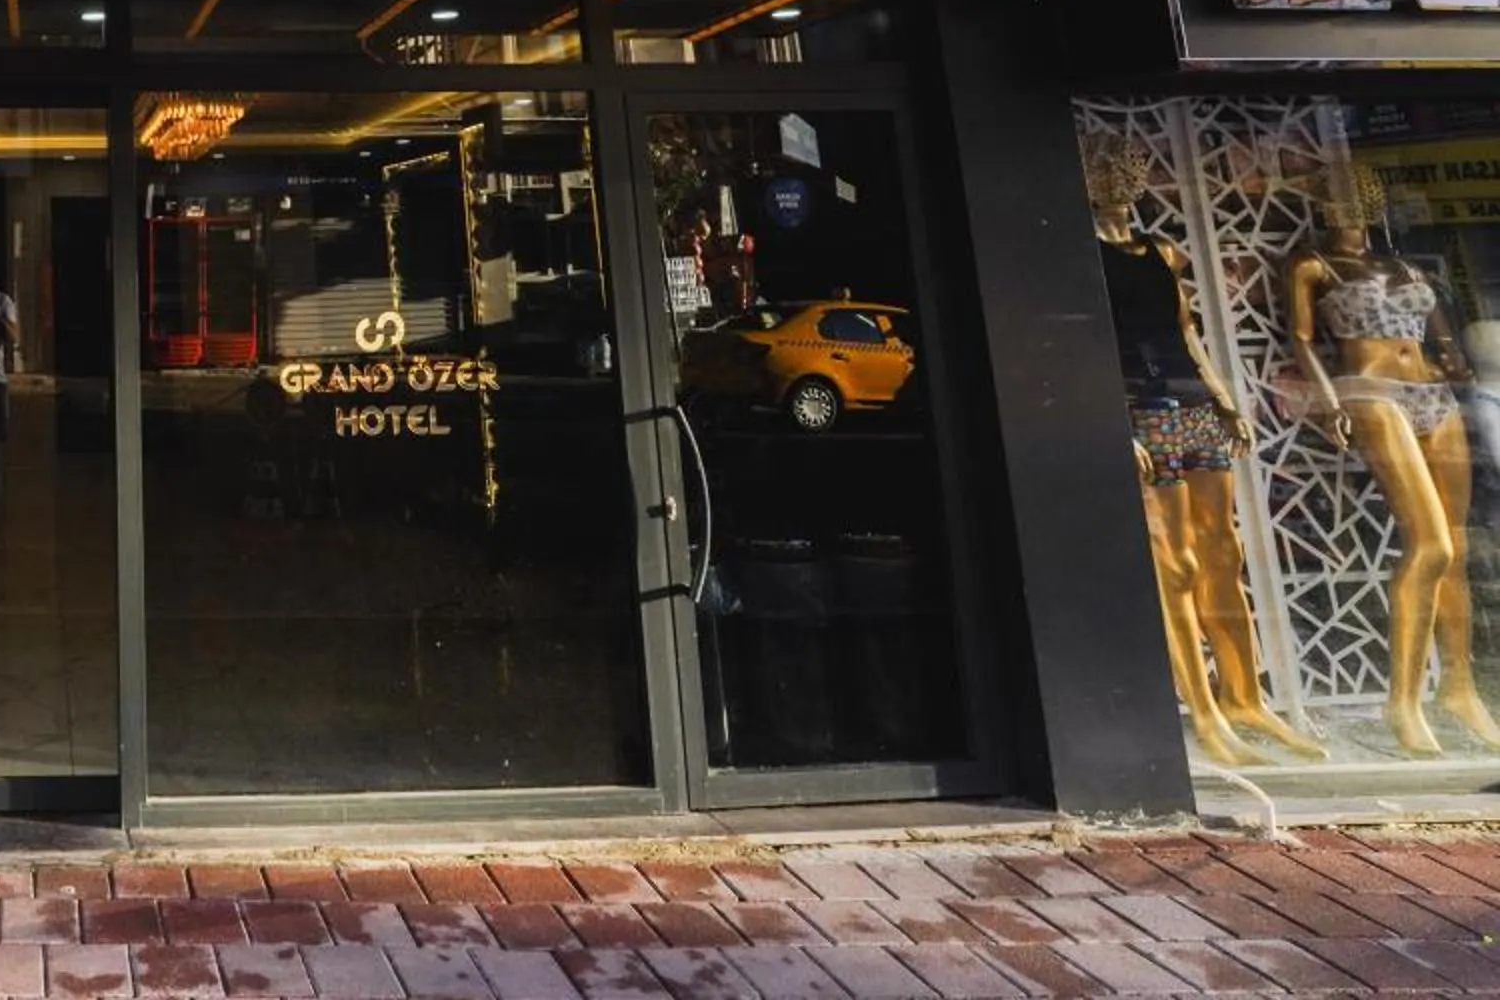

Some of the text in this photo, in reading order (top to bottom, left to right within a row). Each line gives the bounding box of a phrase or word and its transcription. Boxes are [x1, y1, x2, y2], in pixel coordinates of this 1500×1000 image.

[280, 355, 500, 394] GRAND ÖZER
[335, 405, 451, 437] HOTEL
